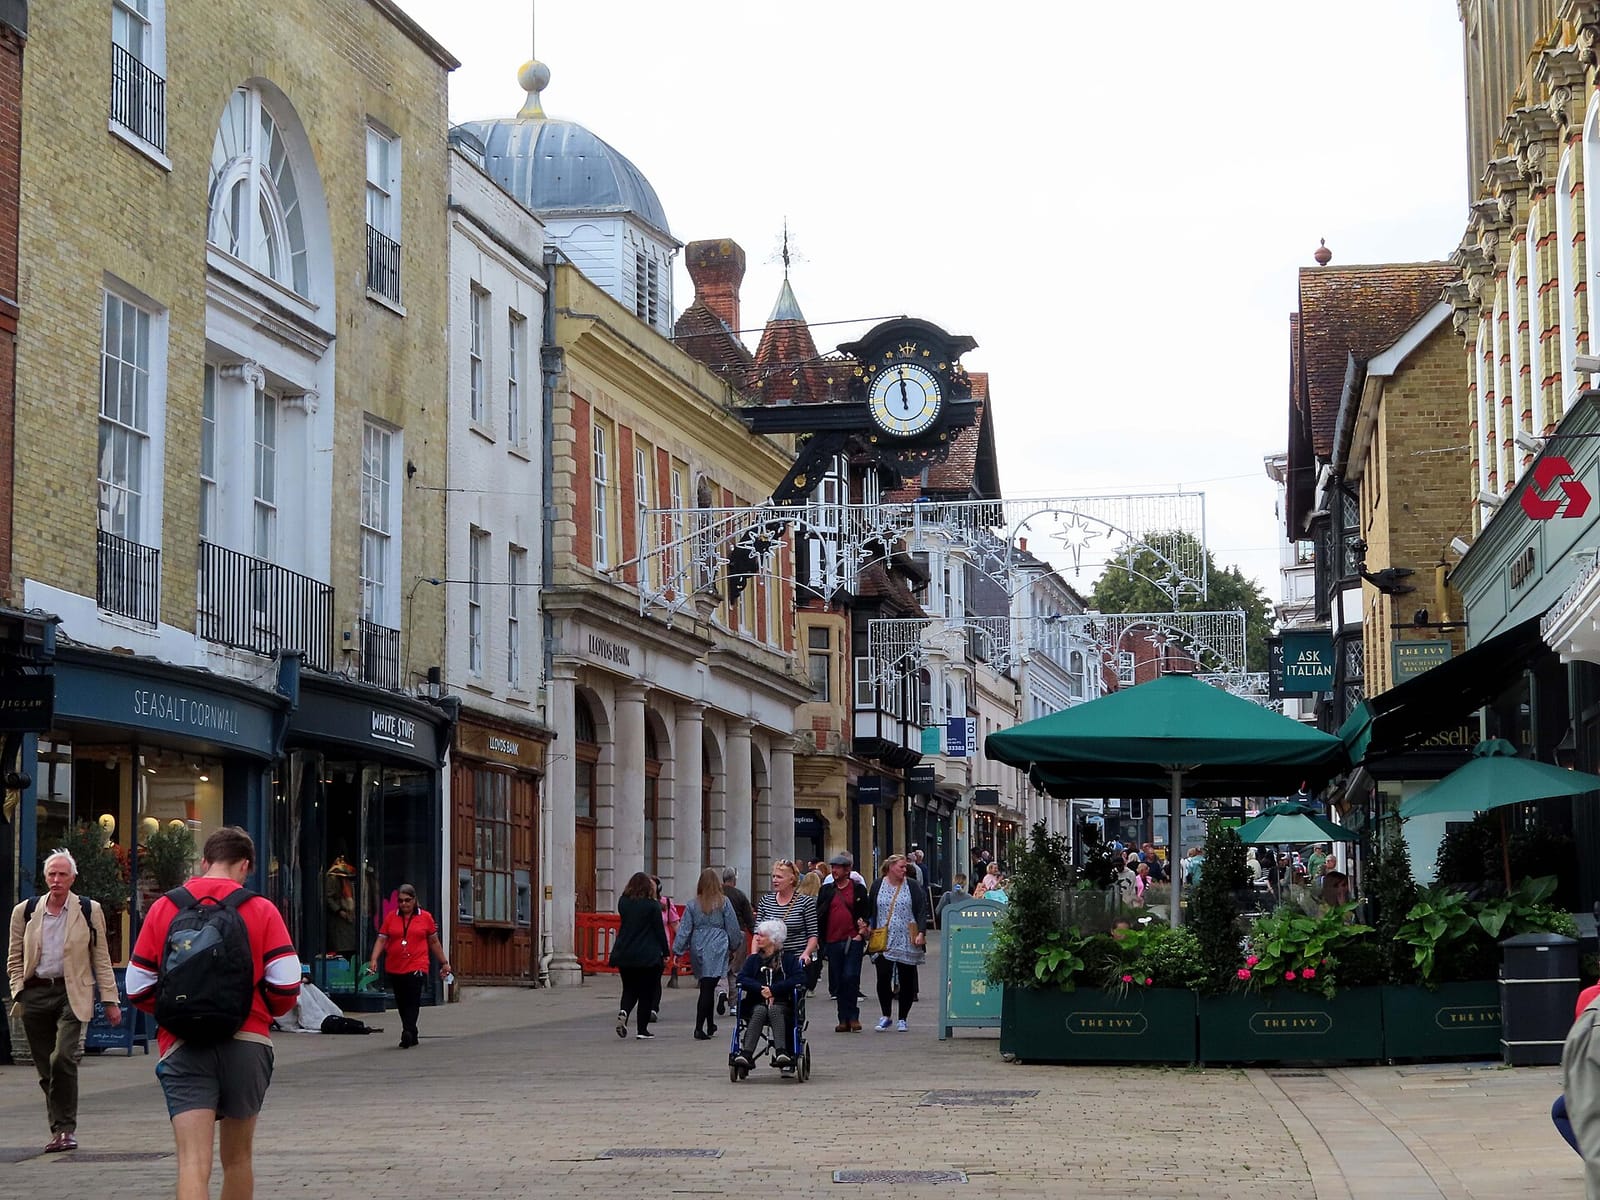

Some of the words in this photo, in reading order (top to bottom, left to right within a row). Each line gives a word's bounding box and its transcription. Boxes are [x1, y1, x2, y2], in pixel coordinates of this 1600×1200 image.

[588, 634, 612, 660] LLOYDS
[612, 644, 630, 667] BANK
[1298, 650, 1320, 662] ASK
[1400, 648, 1418, 656] THE
[1424, 647, 1445, 655] IVY
[1286, 665, 1332, 676] ITALIAN
[134, 689, 187, 722] SEASALT
[190, 701, 239, 735] CORNWALL
[371, 711, 396, 735] WHITE
[397, 718, 415, 740] STUFF
[967, 721, 975, 733] TO
[1424, 725, 1469, 746] ssell
[489, 736, 506, 752] LLOYDS
[506, 741, 519, 756] BANK
[967, 736, 975, 753] LET
[1080, 1019, 1103, 1027] THE
[1109, 1019, 1133, 1027] IVY
[1263, 1019, 1288, 1027] THE
[1293, 1019, 1317, 1027] IVY
[1449, 1013, 1475, 1022] THE
